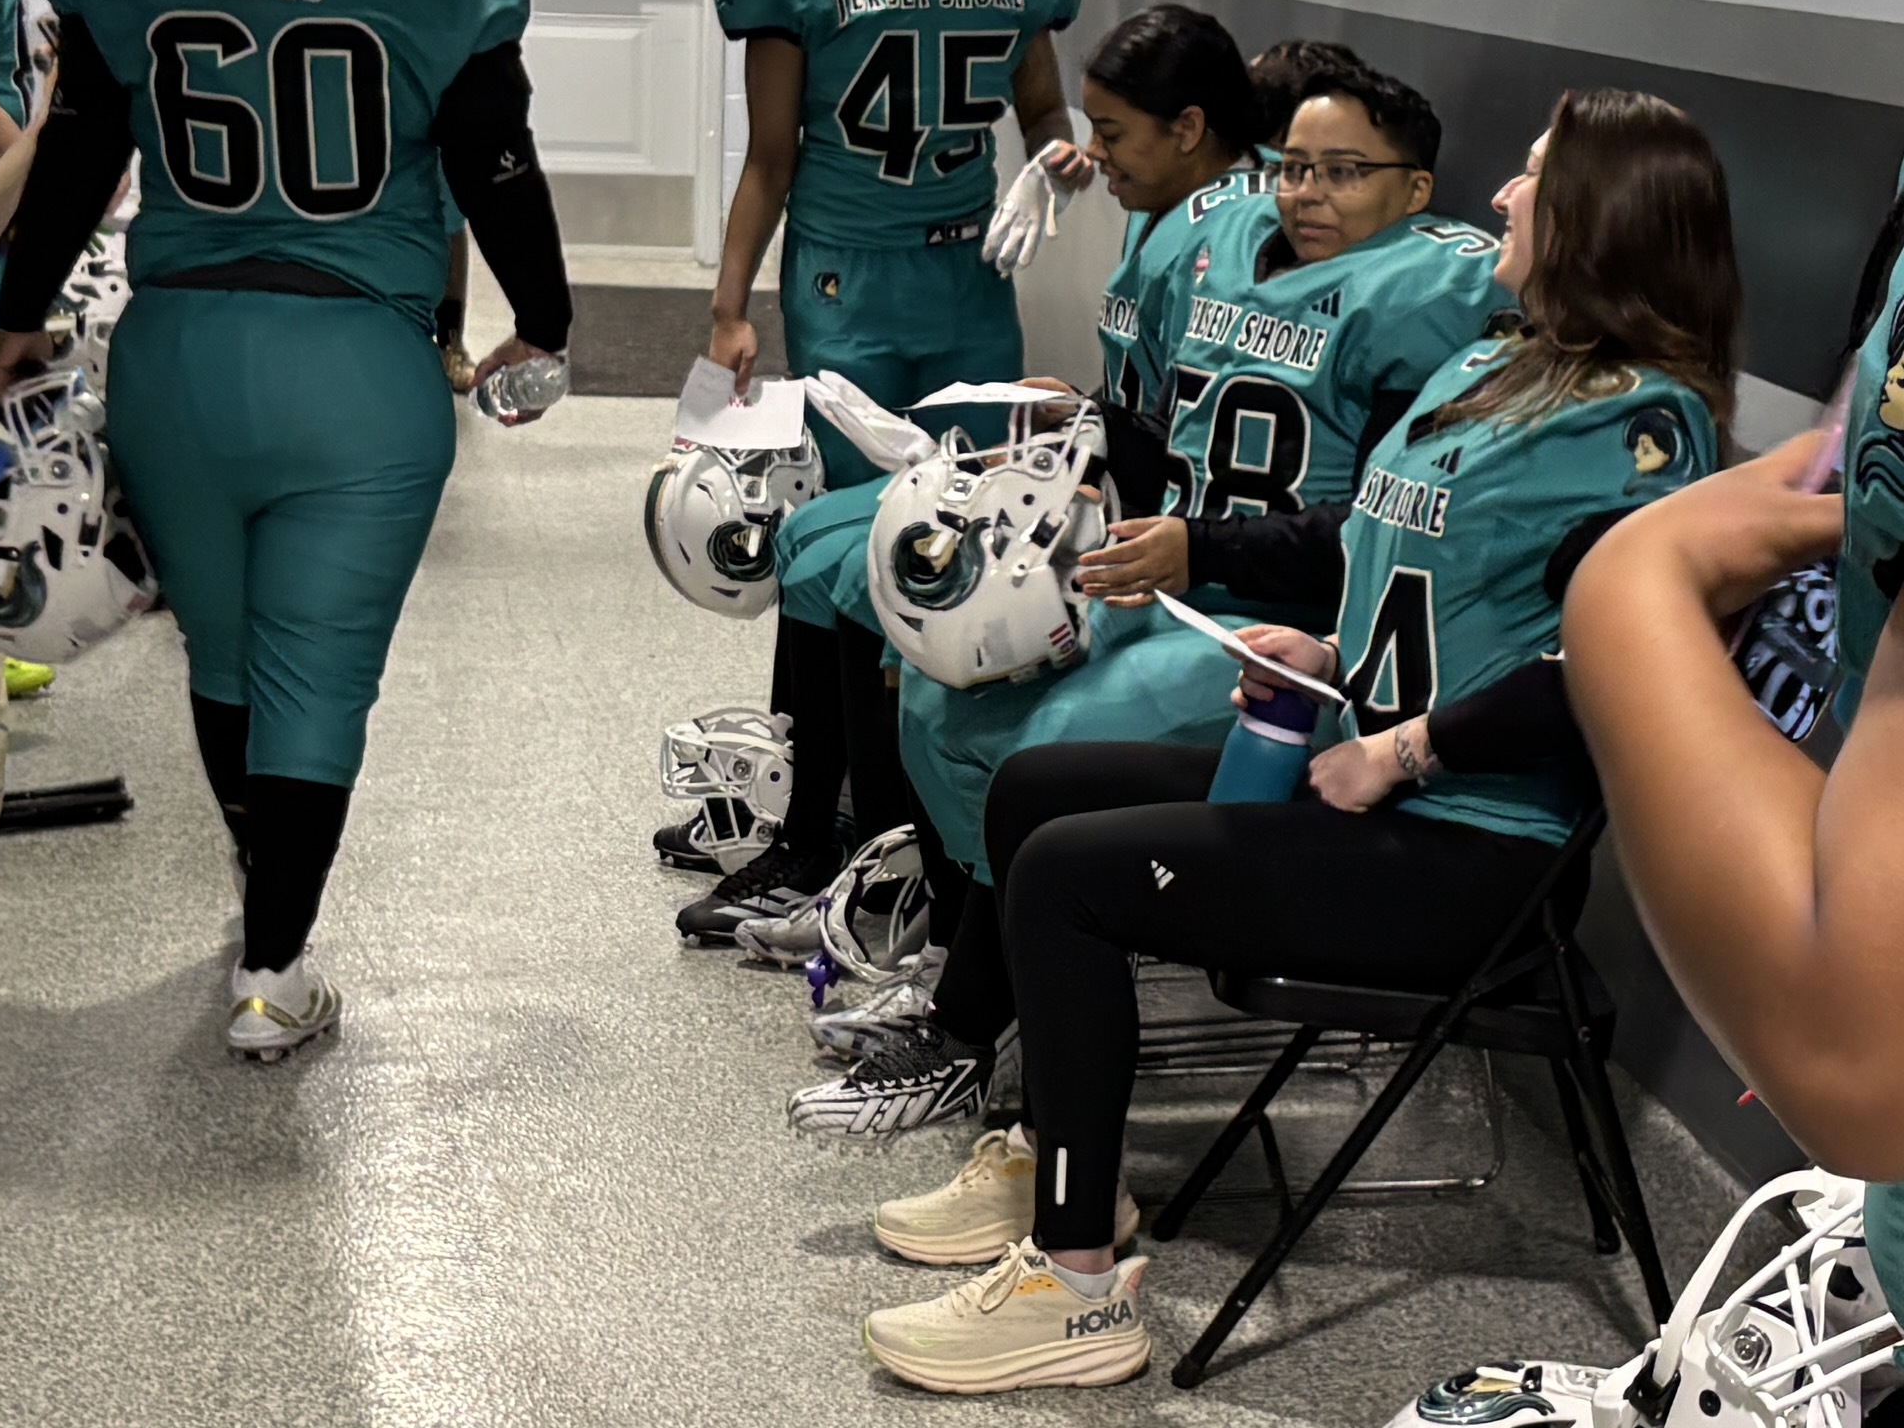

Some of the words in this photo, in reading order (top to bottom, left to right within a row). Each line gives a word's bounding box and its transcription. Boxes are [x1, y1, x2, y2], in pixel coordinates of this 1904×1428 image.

[146, 10, 392, 222] 60
[835, 29, 1022, 186] 45
[1235, 310, 1328, 372] SHORE
[1065, 1299, 1133, 1339] HOKA
